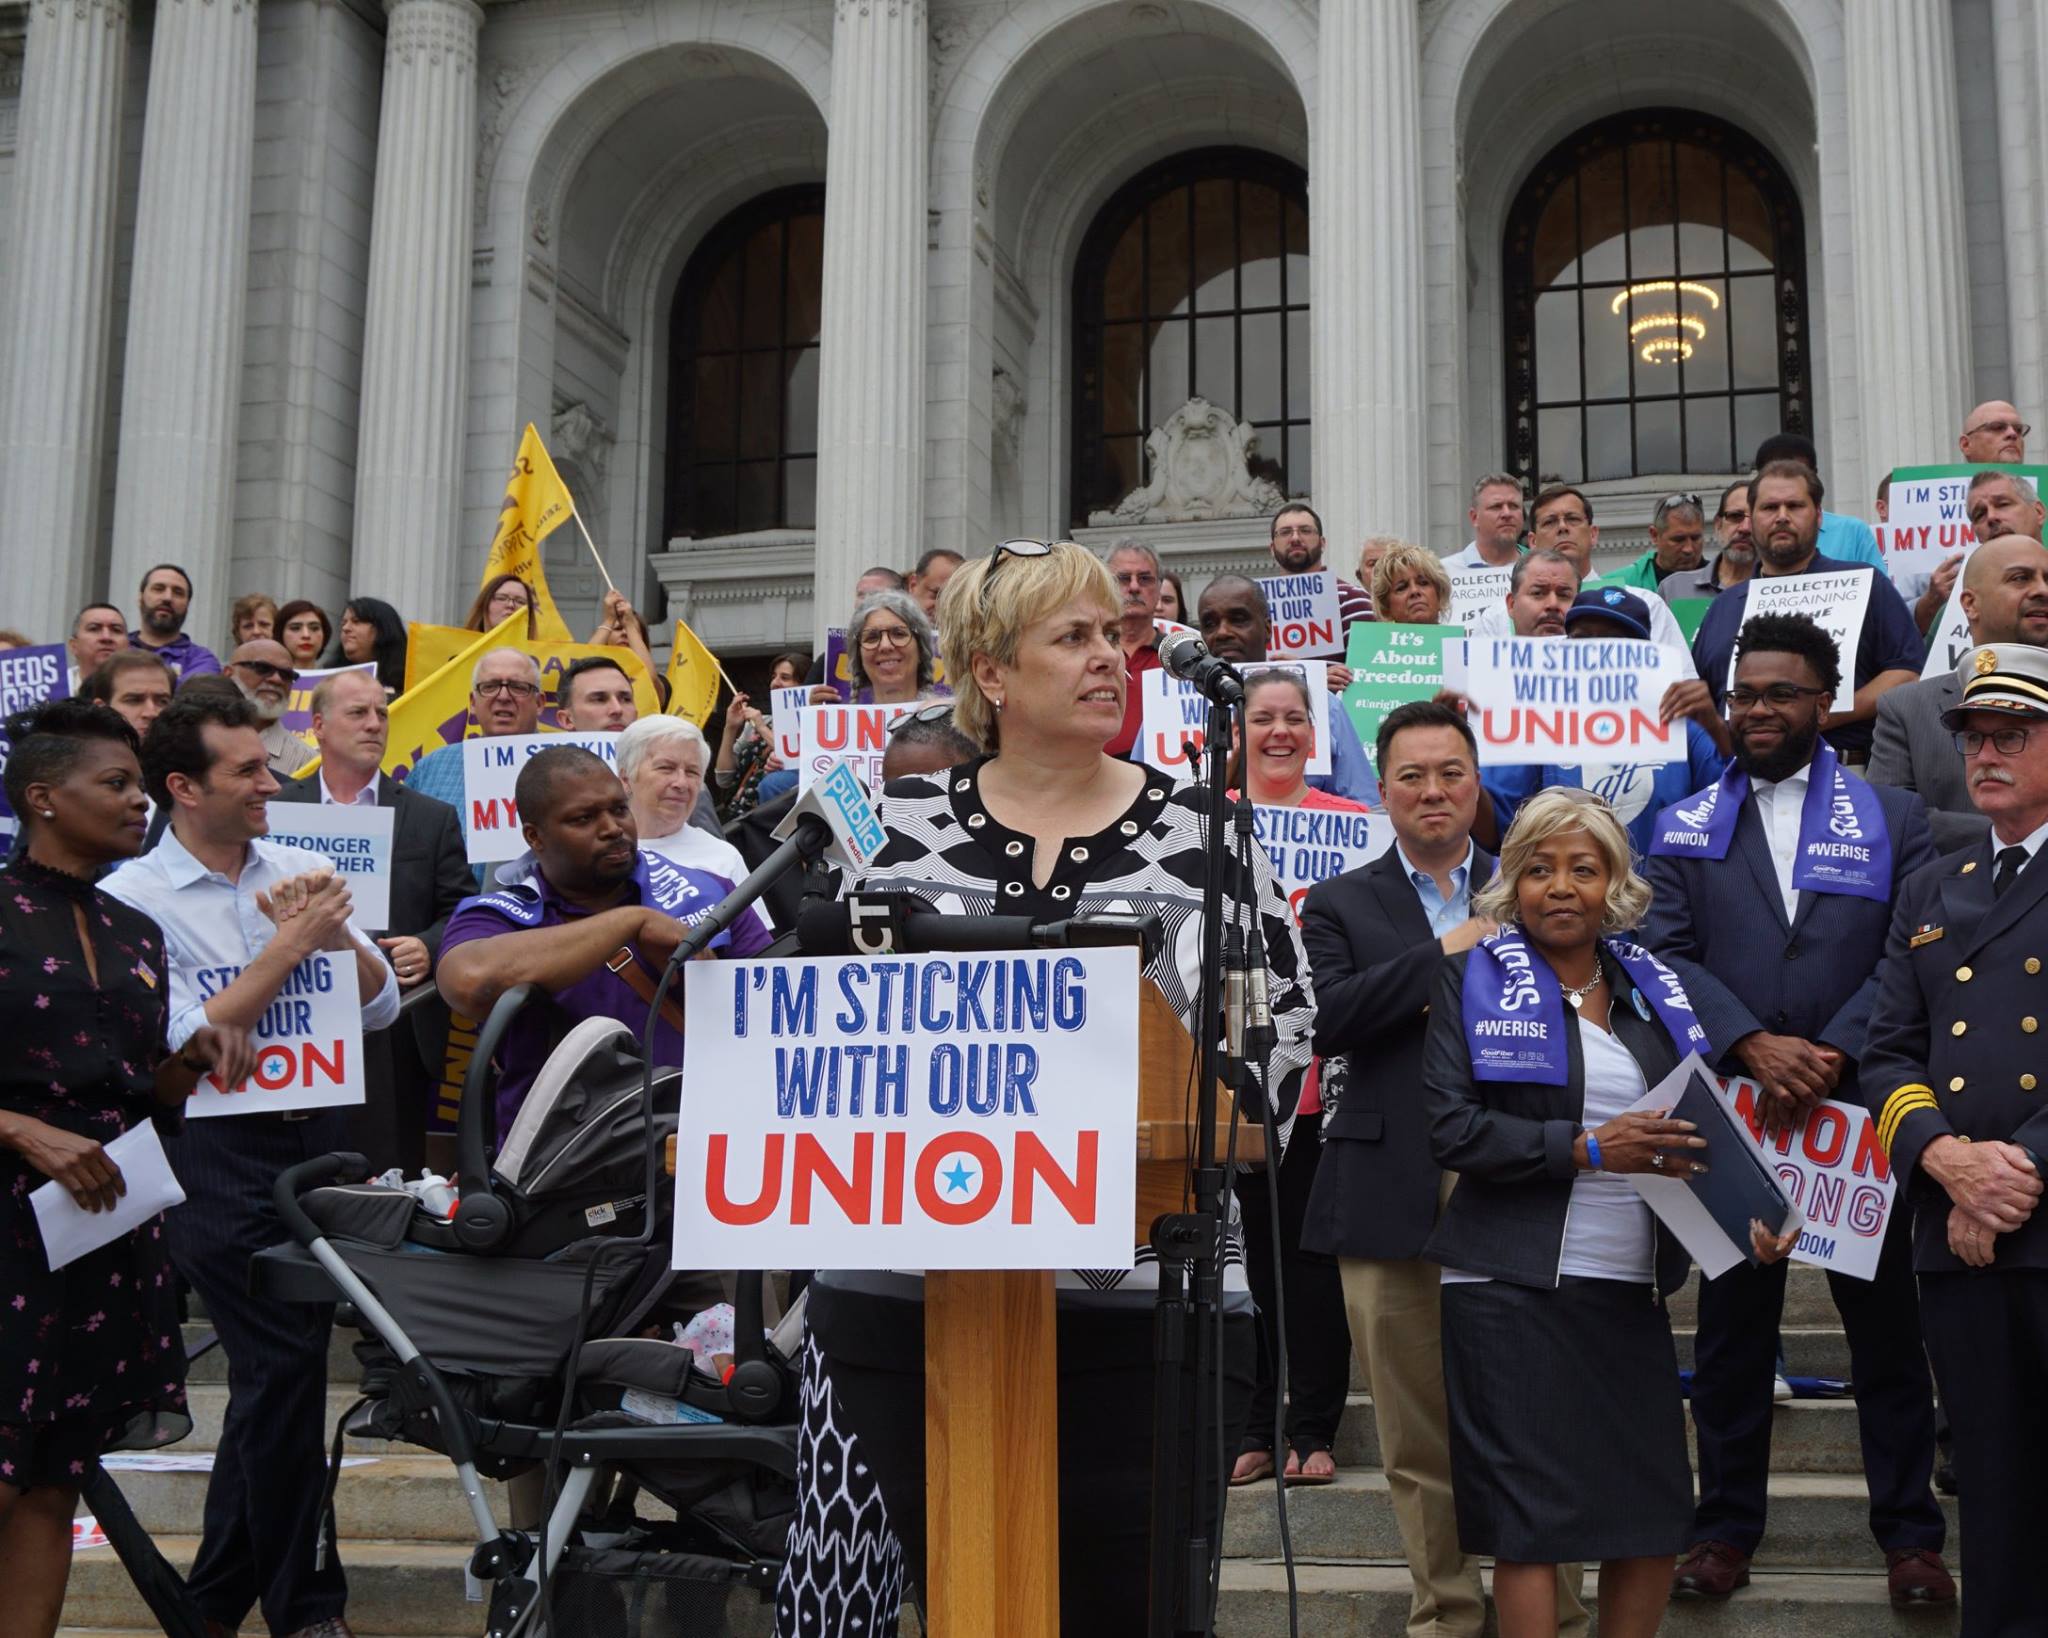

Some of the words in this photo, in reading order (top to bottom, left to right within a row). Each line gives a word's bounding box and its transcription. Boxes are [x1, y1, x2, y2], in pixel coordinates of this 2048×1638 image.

[1906, 487, 1930, 504] I'M
[1894, 525, 1932, 551] MY
[1259, 574, 1324, 599] TICKING
[1760, 577, 1861, 596] COLLECTIVE
[1281, 599, 1313, 620] OUR
[1756, 590, 1858, 610] BARGAINING
[1389, 631, 1424, 646] It's
[1371, 650, 1438, 665] About
[1492, 640, 1534, 669] I'M
[1542, 640, 1660, 670] STICKING
[0, 654, 59, 690] EEDS
[1352, 668, 1443, 685] Freedom
[783, 688, 806, 710] I'M
[1513, 673, 1579, 704] WITH
[1588, 673, 1640, 703] OUR
[1482, 707, 1670, 746] UNION
[484, 745, 514, 767] I'M
[473, 797, 518, 831] MY
[826, 771, 877, 853] public
[1253, 807, 1369, 849] STICKING
[1663, 831, 1710, 847] #UNION
[846, 836, 863, 864] Radio
[1807, 842, 1870, 862] #WERISE
[1294, 848, 1346, 881] OUR
[734, 965, 818, 1037] I'M
[836, 957, 1087, 1035] STICKING
[256, 1000, 312, 1039] OUR
[1475, 1020, 1548, 1039] #WERISE
[775, 1044, 911, 1118] WITH
[928, 1043, 1040, 1117] OUR
[705, 1130, 1099, 1225] UNION
